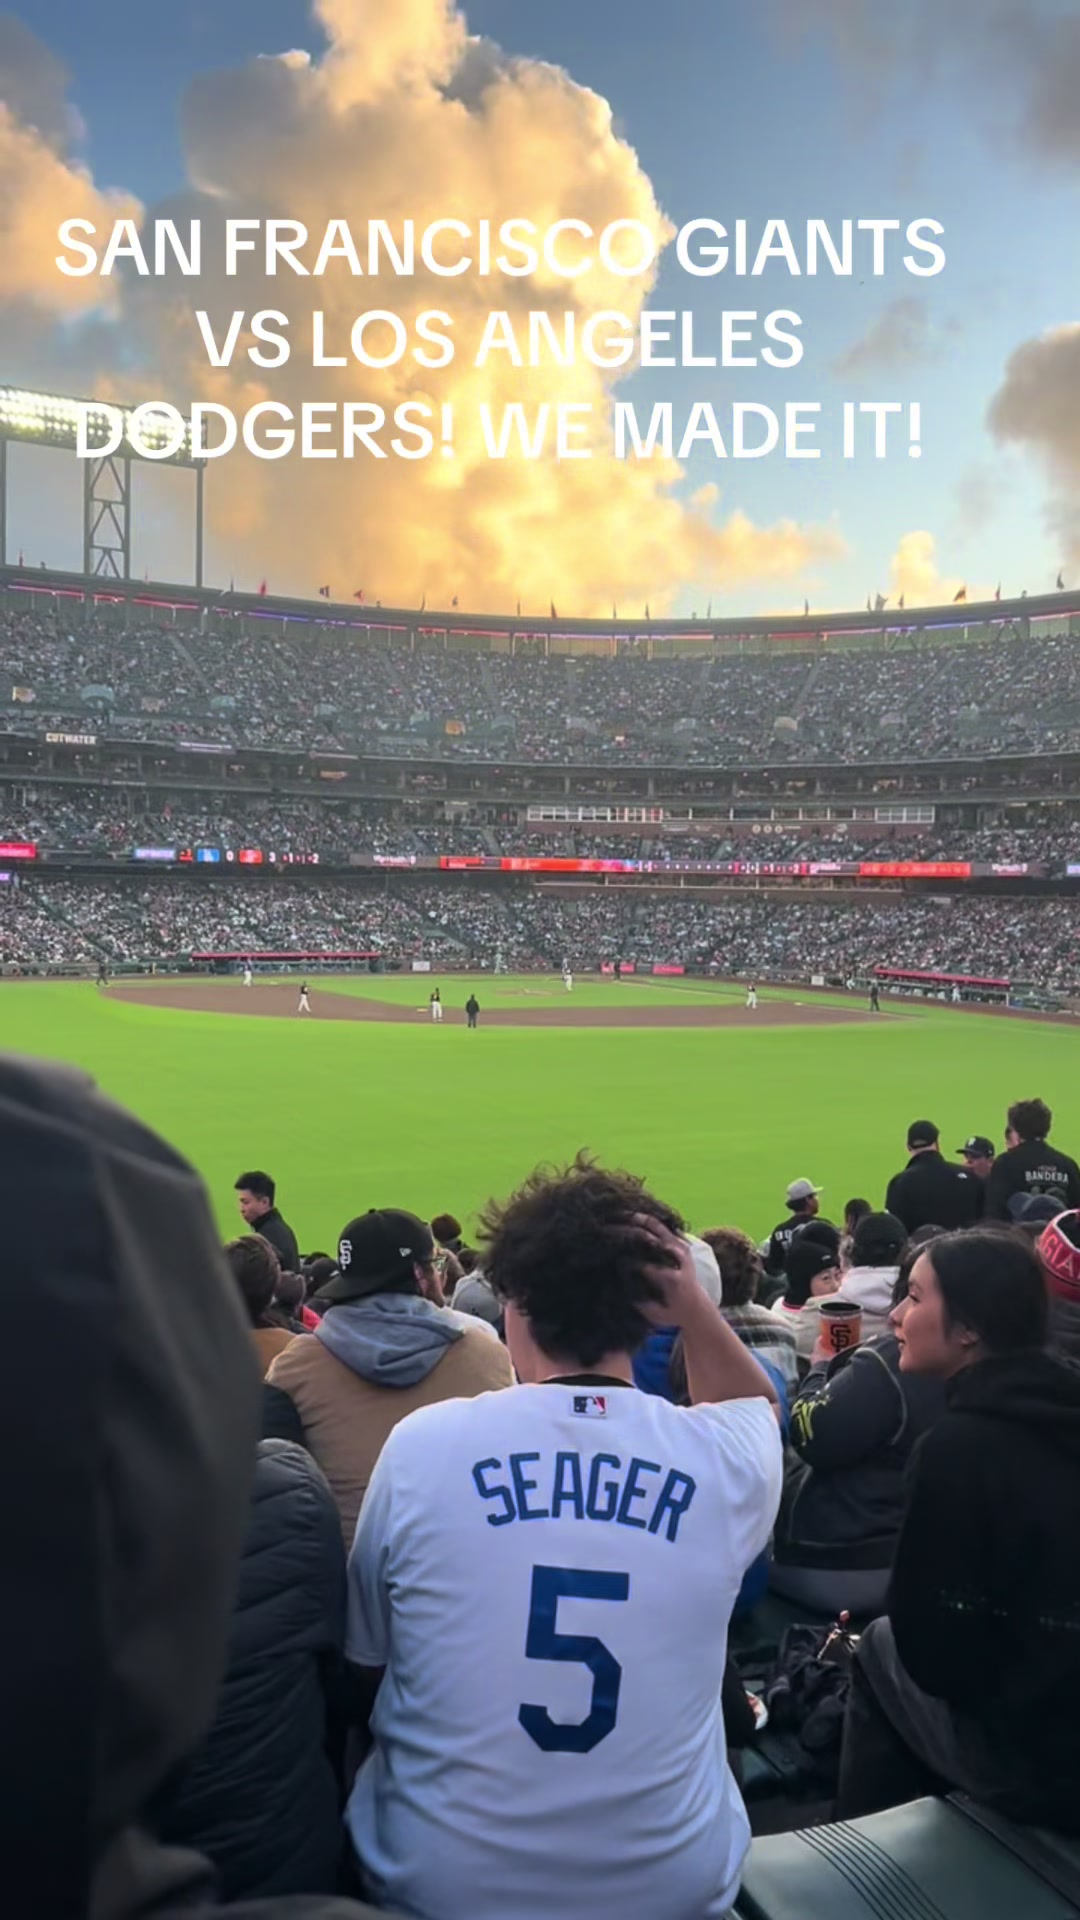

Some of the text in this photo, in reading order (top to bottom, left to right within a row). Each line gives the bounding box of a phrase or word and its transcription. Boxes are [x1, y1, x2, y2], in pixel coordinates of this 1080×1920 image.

[45, 732, 98, 746] CUTWATER
[1025, 1170, 1069, 1184] BANDERA
[1043, 1233, 1080, 1279] GIA
[472, 1451, 697, 1543] SEAGER
[518, 1564, 630, 1753] 5
